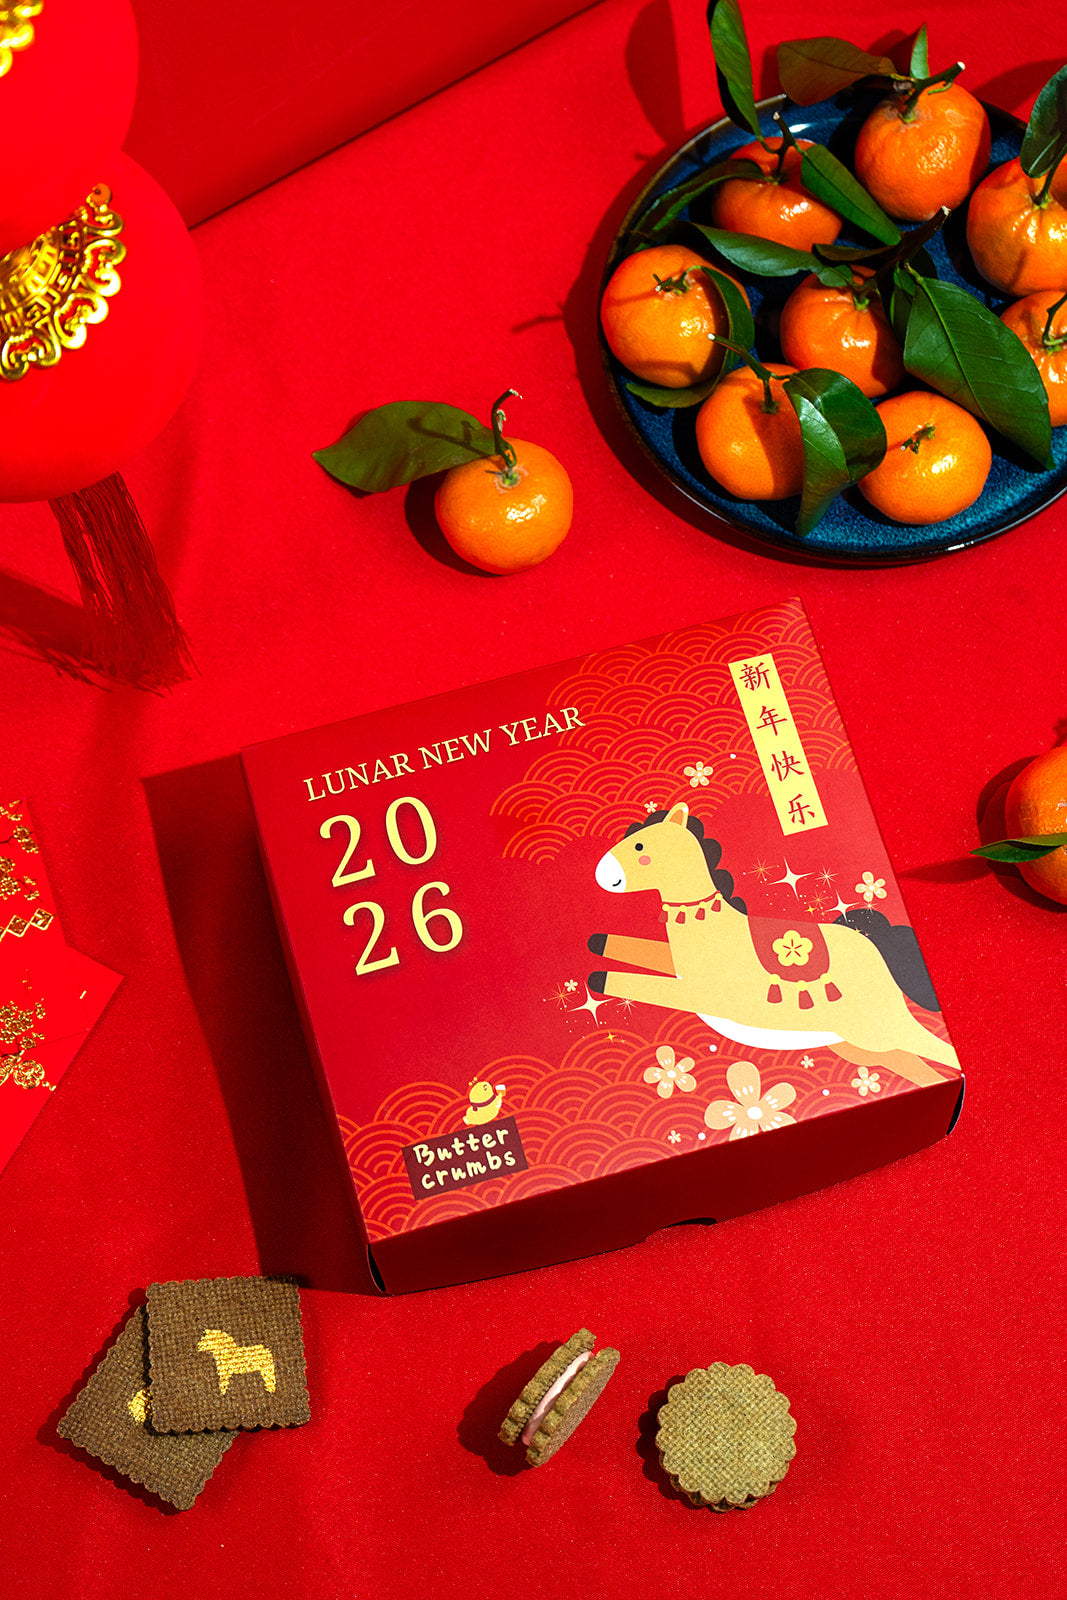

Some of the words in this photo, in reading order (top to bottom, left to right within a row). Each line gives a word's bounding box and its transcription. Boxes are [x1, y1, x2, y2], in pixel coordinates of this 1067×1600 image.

[303, 752, 415, 801] LUNAR
[418, 729, 492, 769] NEW
[499, 706, 586, 746] YEAR
[739, 662, 815, 825] 新年快乐
[319, 796, 437, 888] 20
[343, 881, 463, 976] 26
[413, 1129, 509, 1167] Butter
[421, 1151, 516, 1190] crumbs
